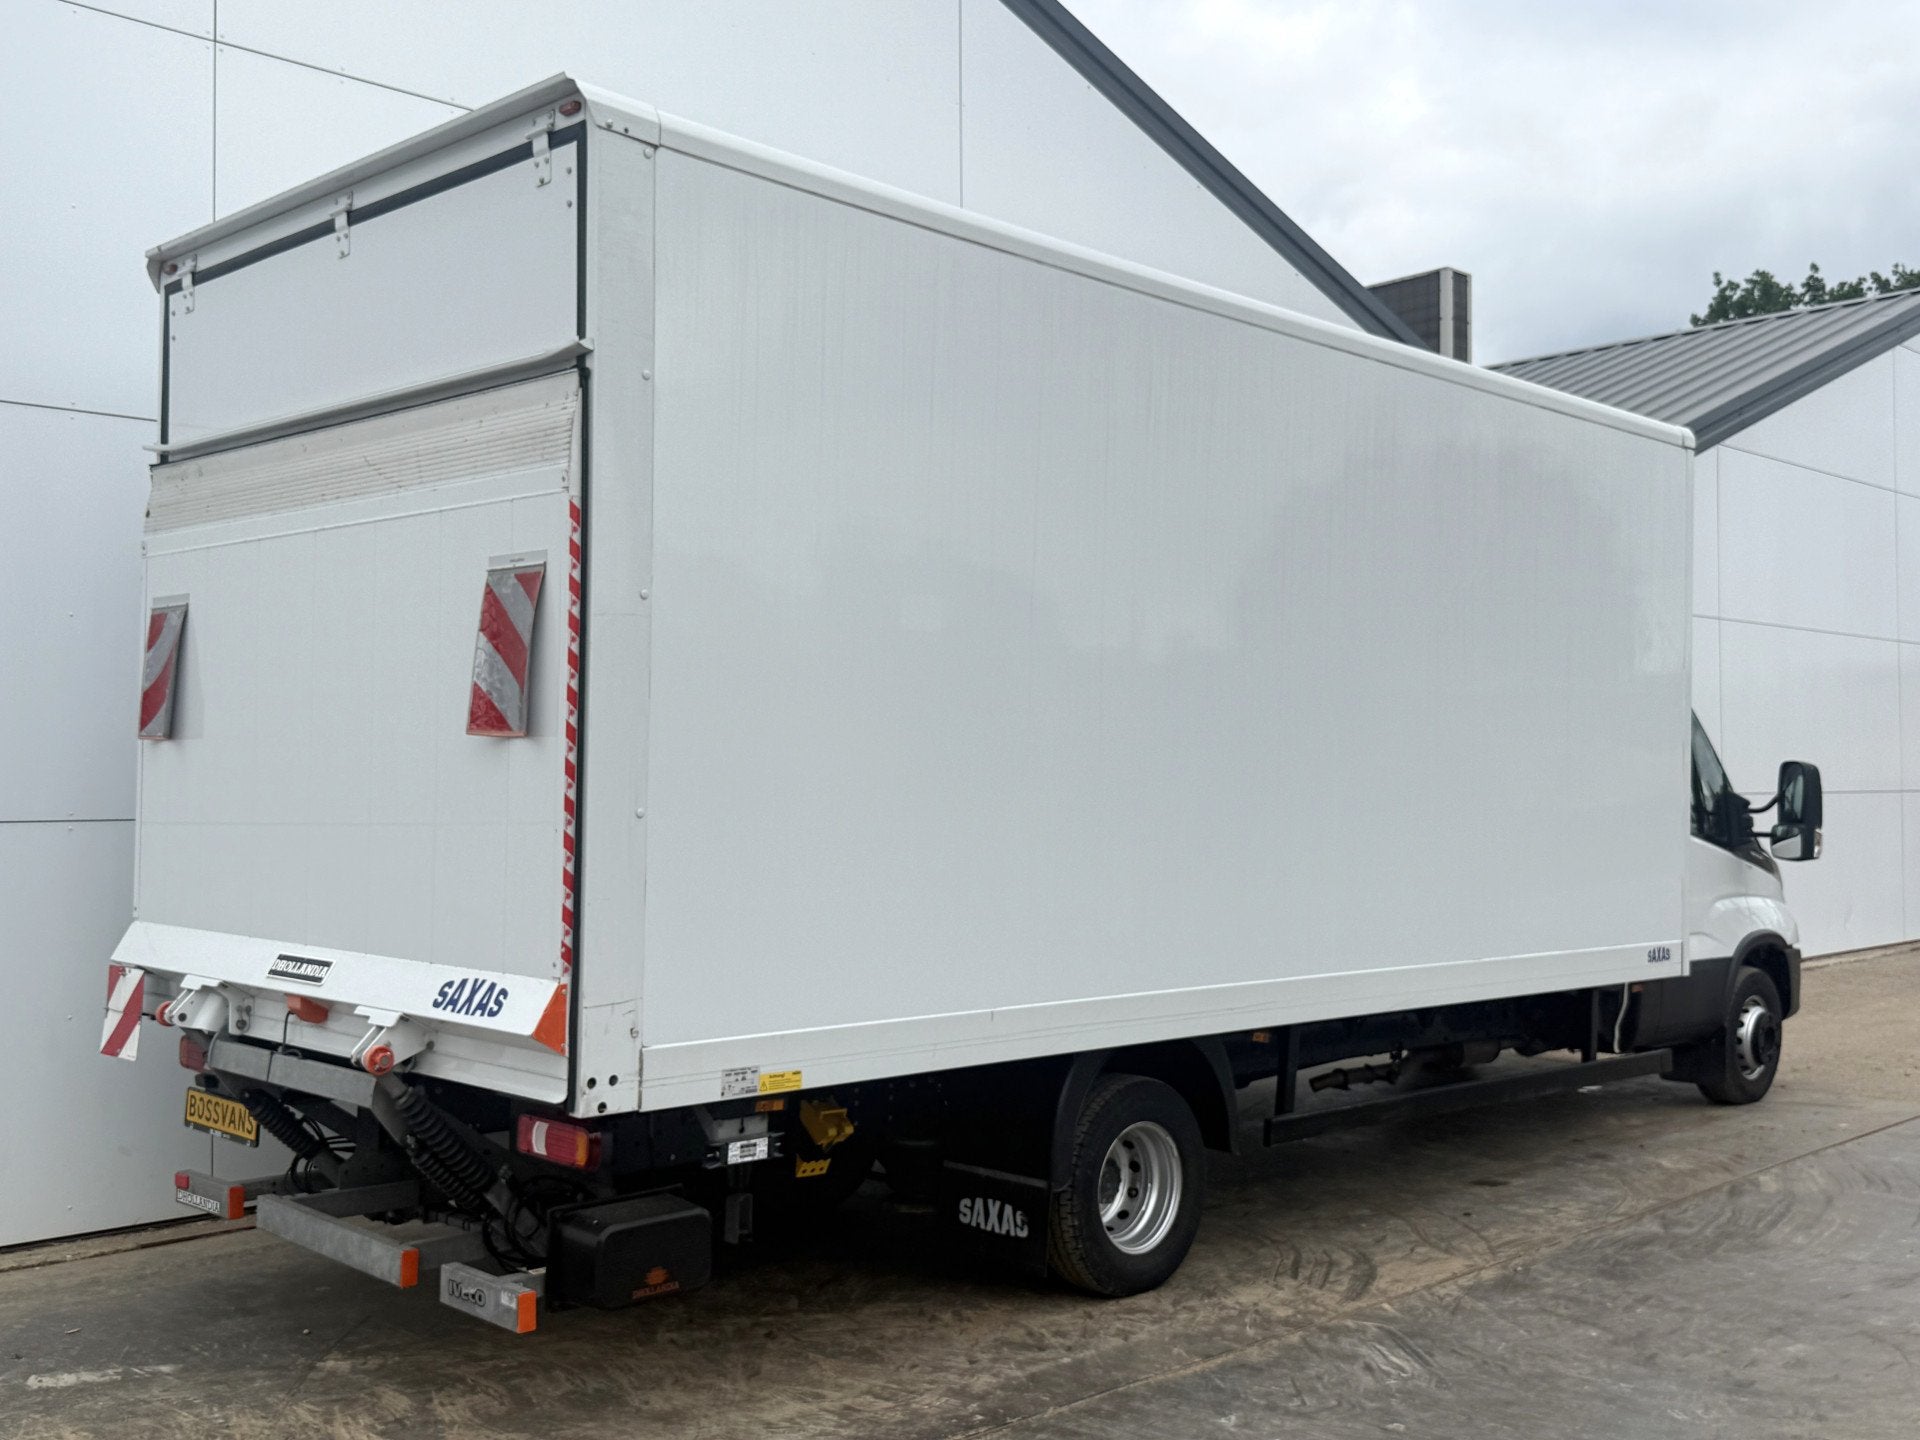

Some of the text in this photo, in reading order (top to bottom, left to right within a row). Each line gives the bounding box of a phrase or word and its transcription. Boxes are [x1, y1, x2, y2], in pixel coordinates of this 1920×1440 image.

[271, 959, 329, 978] DHOLLANDIA
[1647, 946, 1671, 963] SAXAS
[432, 978, 509, 1017] SAXAS
[189, 1095, 254, 1135] BOSSVANS
[959, 1197, 1029, 1238] SAXAS
